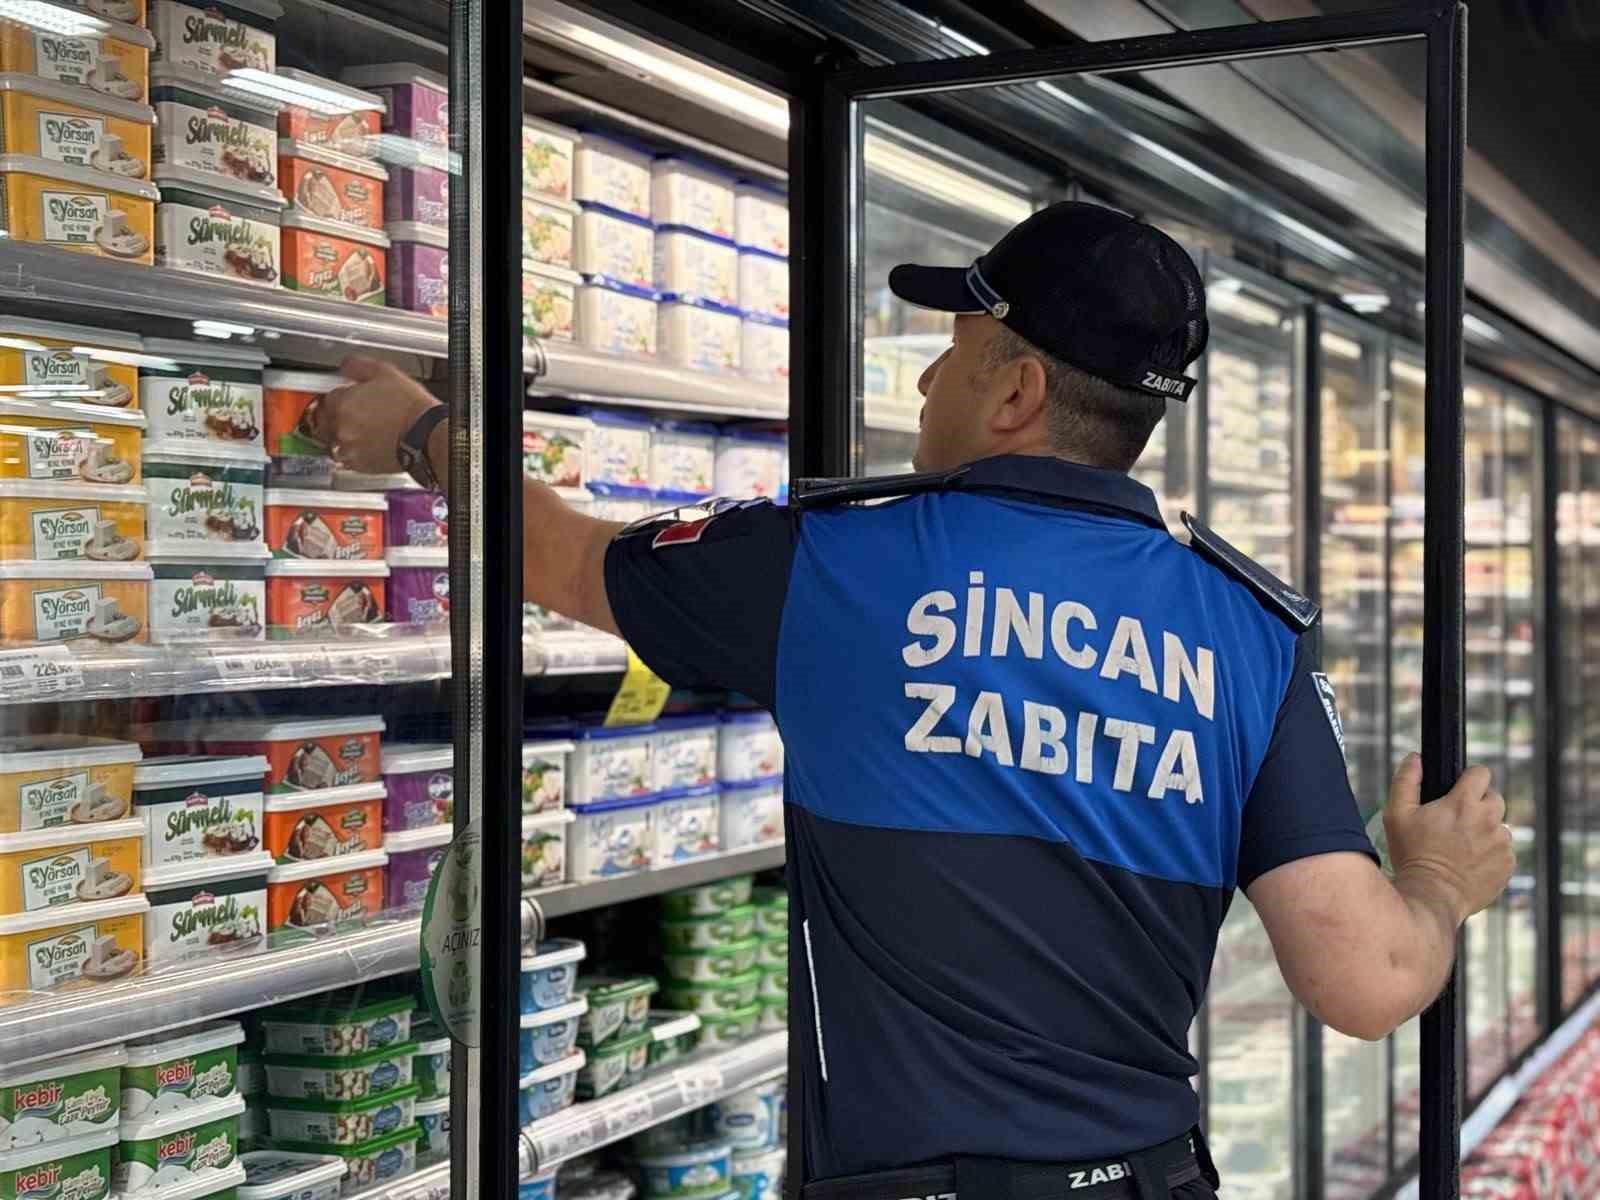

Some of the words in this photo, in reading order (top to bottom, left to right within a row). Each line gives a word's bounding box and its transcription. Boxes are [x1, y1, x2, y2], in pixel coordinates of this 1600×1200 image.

[46, 119, 95, 144] Yörsan
[49, 199, 98, 221] Yörsan
[31, 356, 80, 378] Yörsan
[1142, 371, 1186, 395] ZABITA
[40, 518, 89, 540] Yörsan
[41, 597, 90, 620] Yörsan
[902, 570, 1214, 721] SİNCAN
[904, 682, 1204, 804] ZABITA
[28, 785, 77, 809] Yörsan
[30, 861, 80, 888] Yörsan
[36, 937, 87, 968] Yörsan
[157, 1060, 195, 1086] kebir
[15, 1083, 62, 1109] kebir
[159, 1132, 195, 1159] kebir
[16, 1164, 62, 1191] kebir
